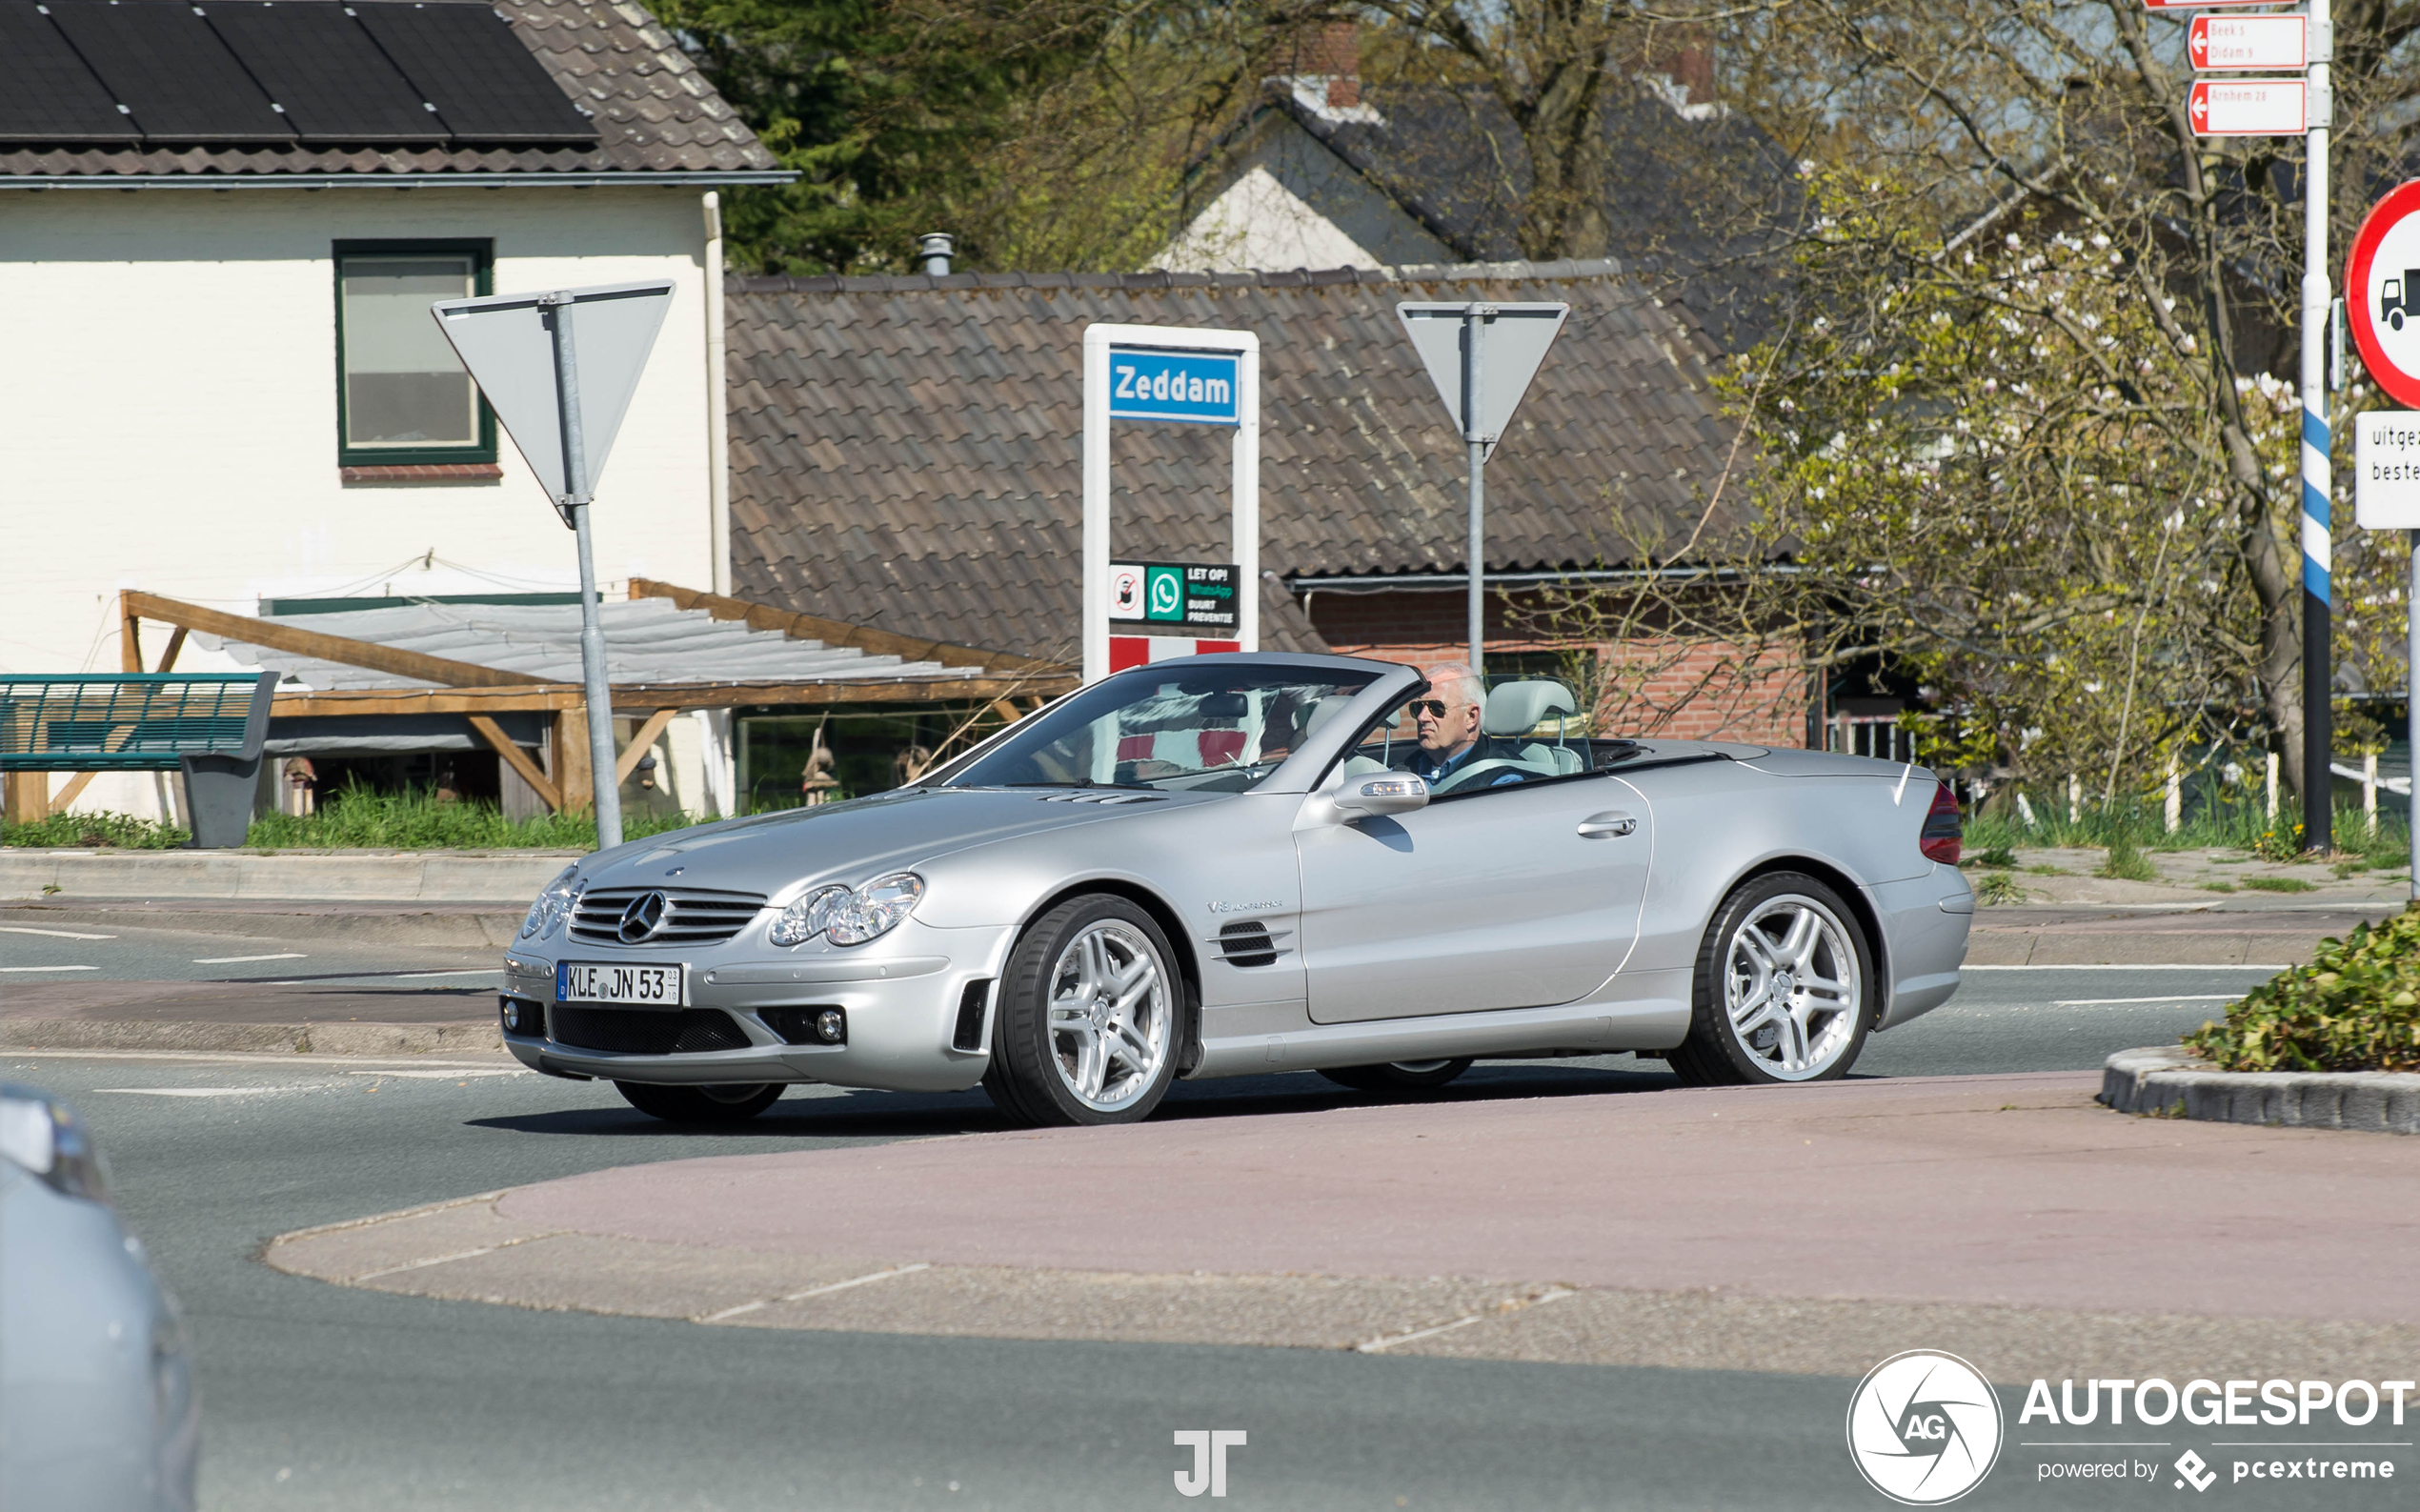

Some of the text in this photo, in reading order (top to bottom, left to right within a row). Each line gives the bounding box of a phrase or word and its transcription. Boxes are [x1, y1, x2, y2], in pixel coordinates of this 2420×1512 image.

[2211, 24, 2235, 36] Beek
[2211, 46, 2244, 58] Didam
[2211, 90, 2252, 101] Arnhem
[1116, 366, 1230, 404] Zeddam
[1188, 568, 1228, 581] LET OP!
[1188, 583, 1233, 598] WhatsApp
[1188, 599, 1217, 610] BUURT
[1187, 612, 1234, 623] PREVENTIE
[569, 967, 665, 999] KLE JN 53
